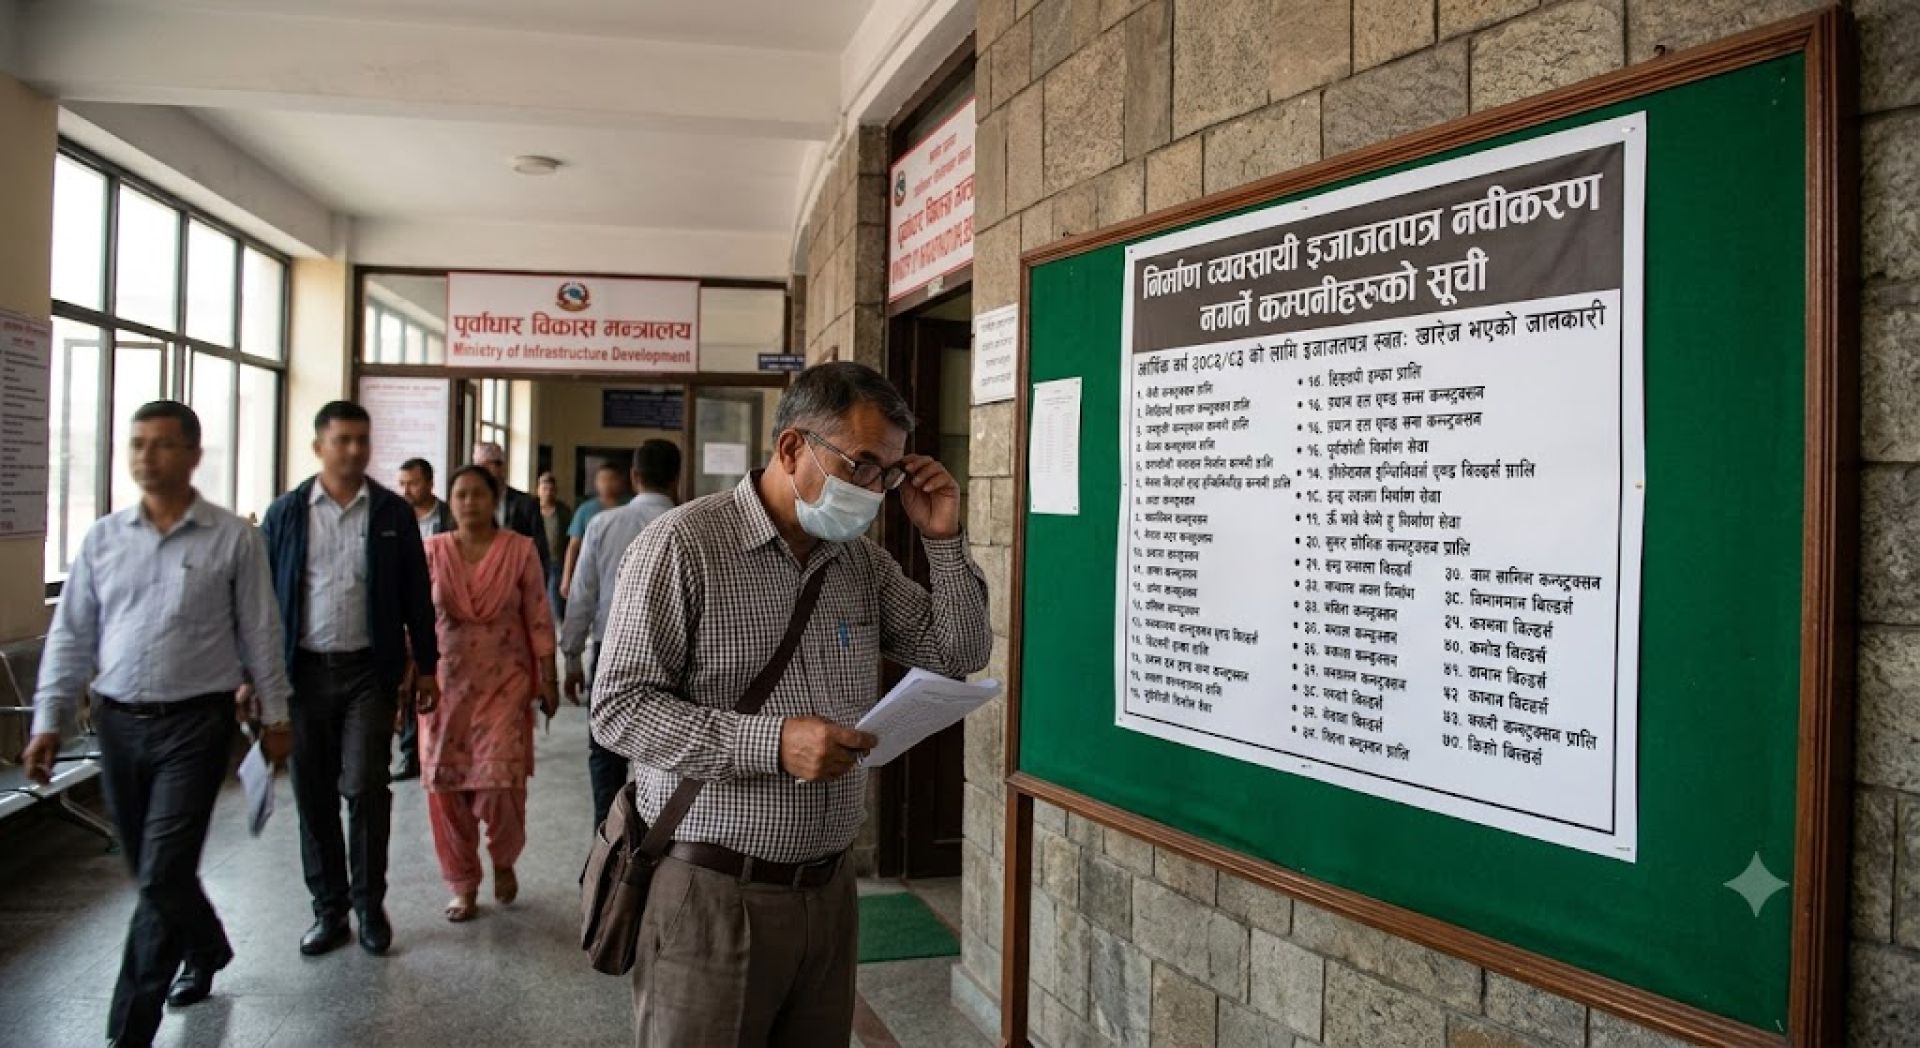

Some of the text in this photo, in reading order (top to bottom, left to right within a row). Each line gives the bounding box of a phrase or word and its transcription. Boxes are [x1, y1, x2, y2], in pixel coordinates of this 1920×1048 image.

[1143, 172, 1604, 299] निर्माण व्यवसायी इजाजतपत्र नवीकरण
[1200, 289, 1253, 331] नगर्ने
[1426, 247, 1489, 306] सूची
[453, 311, 692, 340] पूर्वाधार विकास मन्त्रालय
[453, 342, 690, 366] Ministry of Infrastructure Development
[1249, 343, 1265, 364] को
[1269, 338, 1298, 363] लागि
[1416, 320, 1461, 345] खारेज
[1468, 311, 1518, 342] भएको
[1525, 298, 1607, 334] जानकारी
